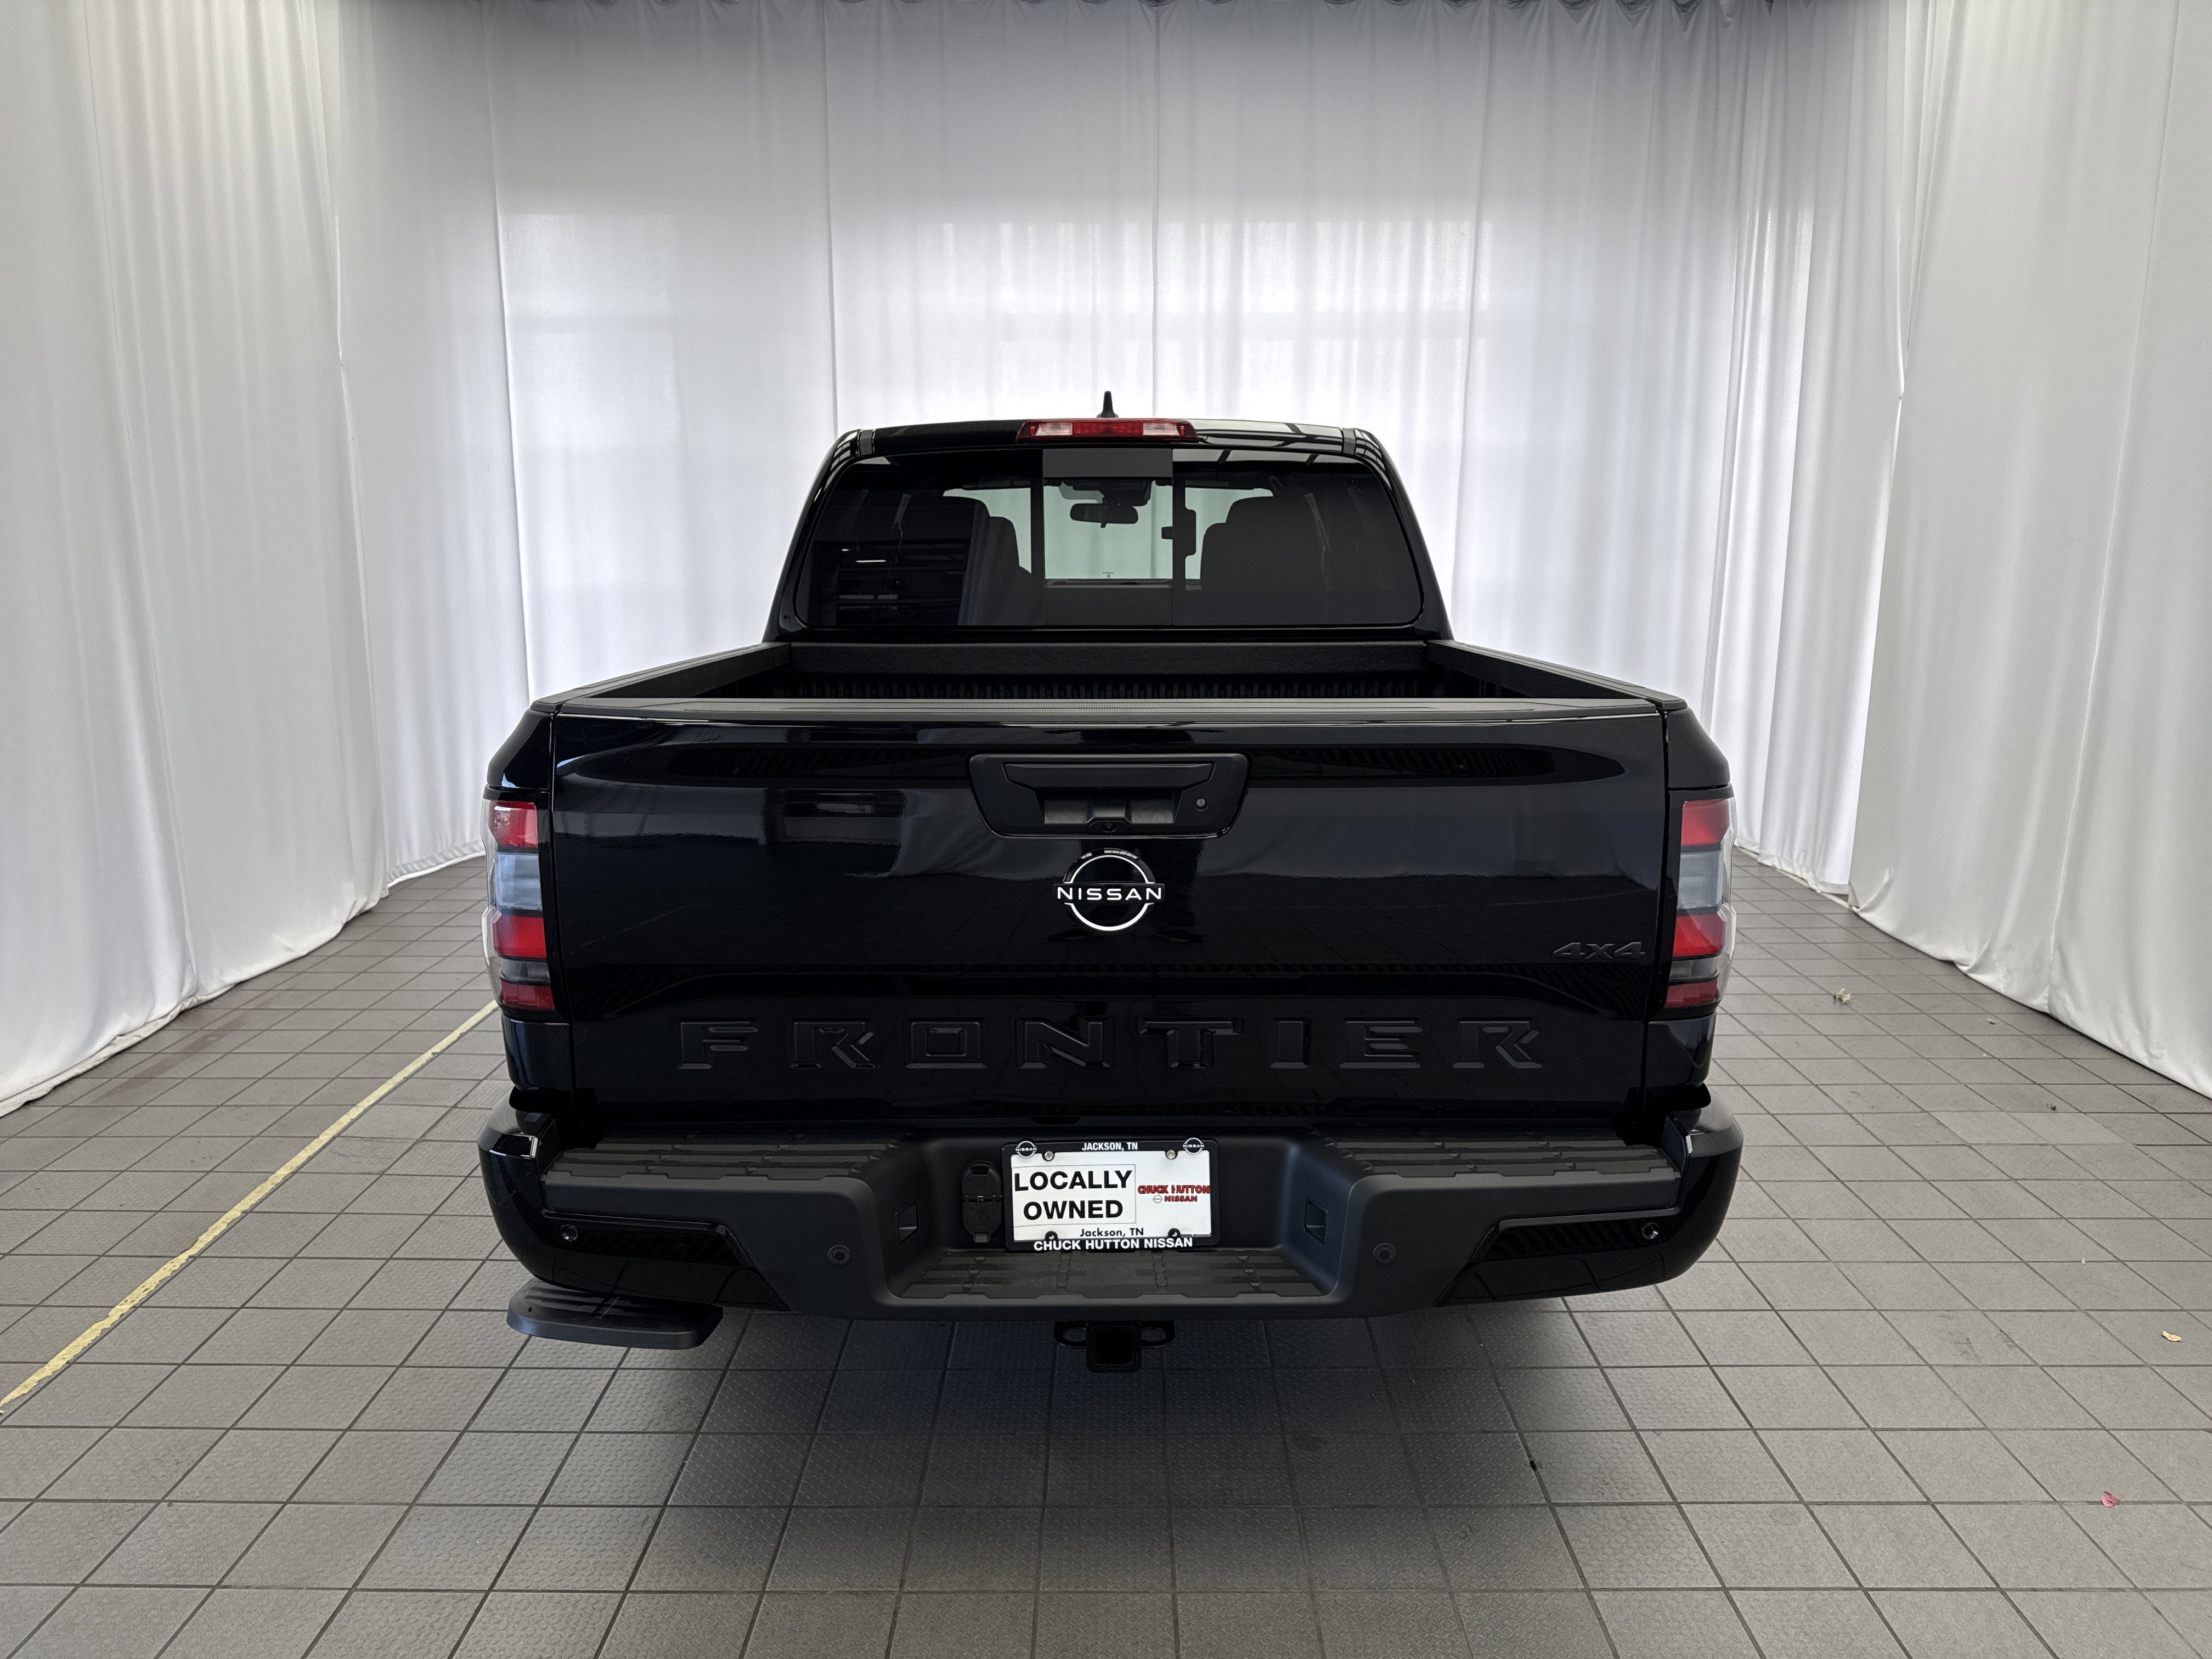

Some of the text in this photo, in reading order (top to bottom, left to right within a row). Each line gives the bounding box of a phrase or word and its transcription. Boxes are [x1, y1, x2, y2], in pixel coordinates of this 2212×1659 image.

[1057, 887, 1162, 901] NISSAN
[677, 1018, 1543, 1069] FRONTIER
[1081, 1142, 1138, 1152] JACKSON, TN
[1014, 1170, 1133, 1192] LOCALLY
[1137, 1184, 1211, 1194] CHUCK HUTTON
[1023, 1200, 1124, 1221] OWNED
[1079, 1228, 1144, 1238] Jackson, TN
[1033, 1237, 1193, 1251] CHUCK HUTTON NISSAN
